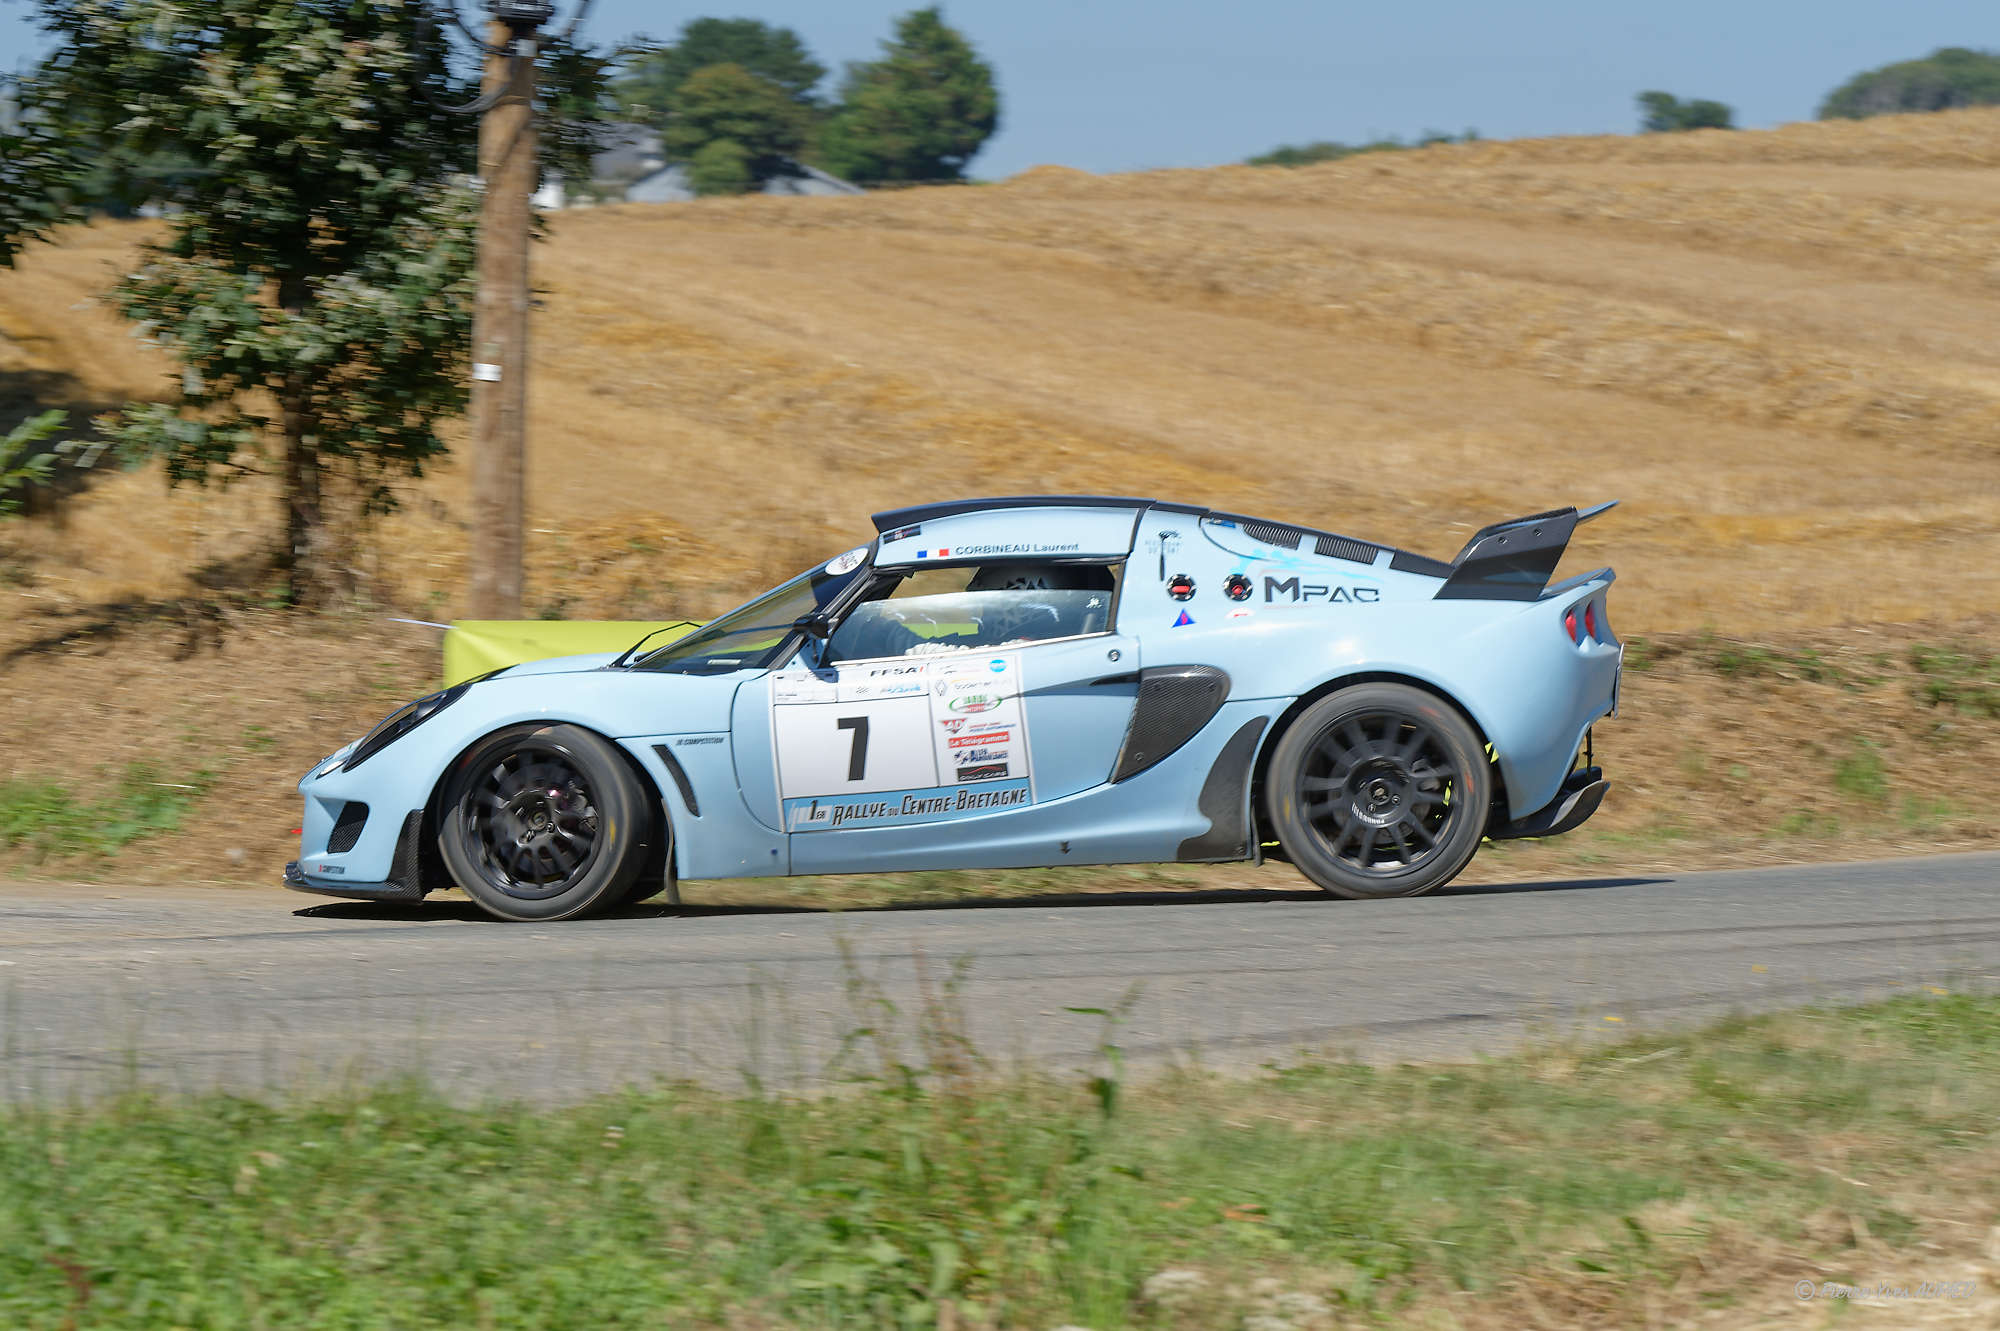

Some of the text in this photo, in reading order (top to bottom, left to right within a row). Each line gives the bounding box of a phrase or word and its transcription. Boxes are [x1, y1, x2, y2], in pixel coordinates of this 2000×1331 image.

[955, 542, 1080, 555] CORBINEAU Laurent
[1263, 576, 1380, 602] MPAC
[870, 667, 919, 678] FFSA
[836, 715, 870, 782] 7
[832, 802, 888, 826] RALLYE
[901, 787, 1029, 816] CENTRE-BRETAGNE
